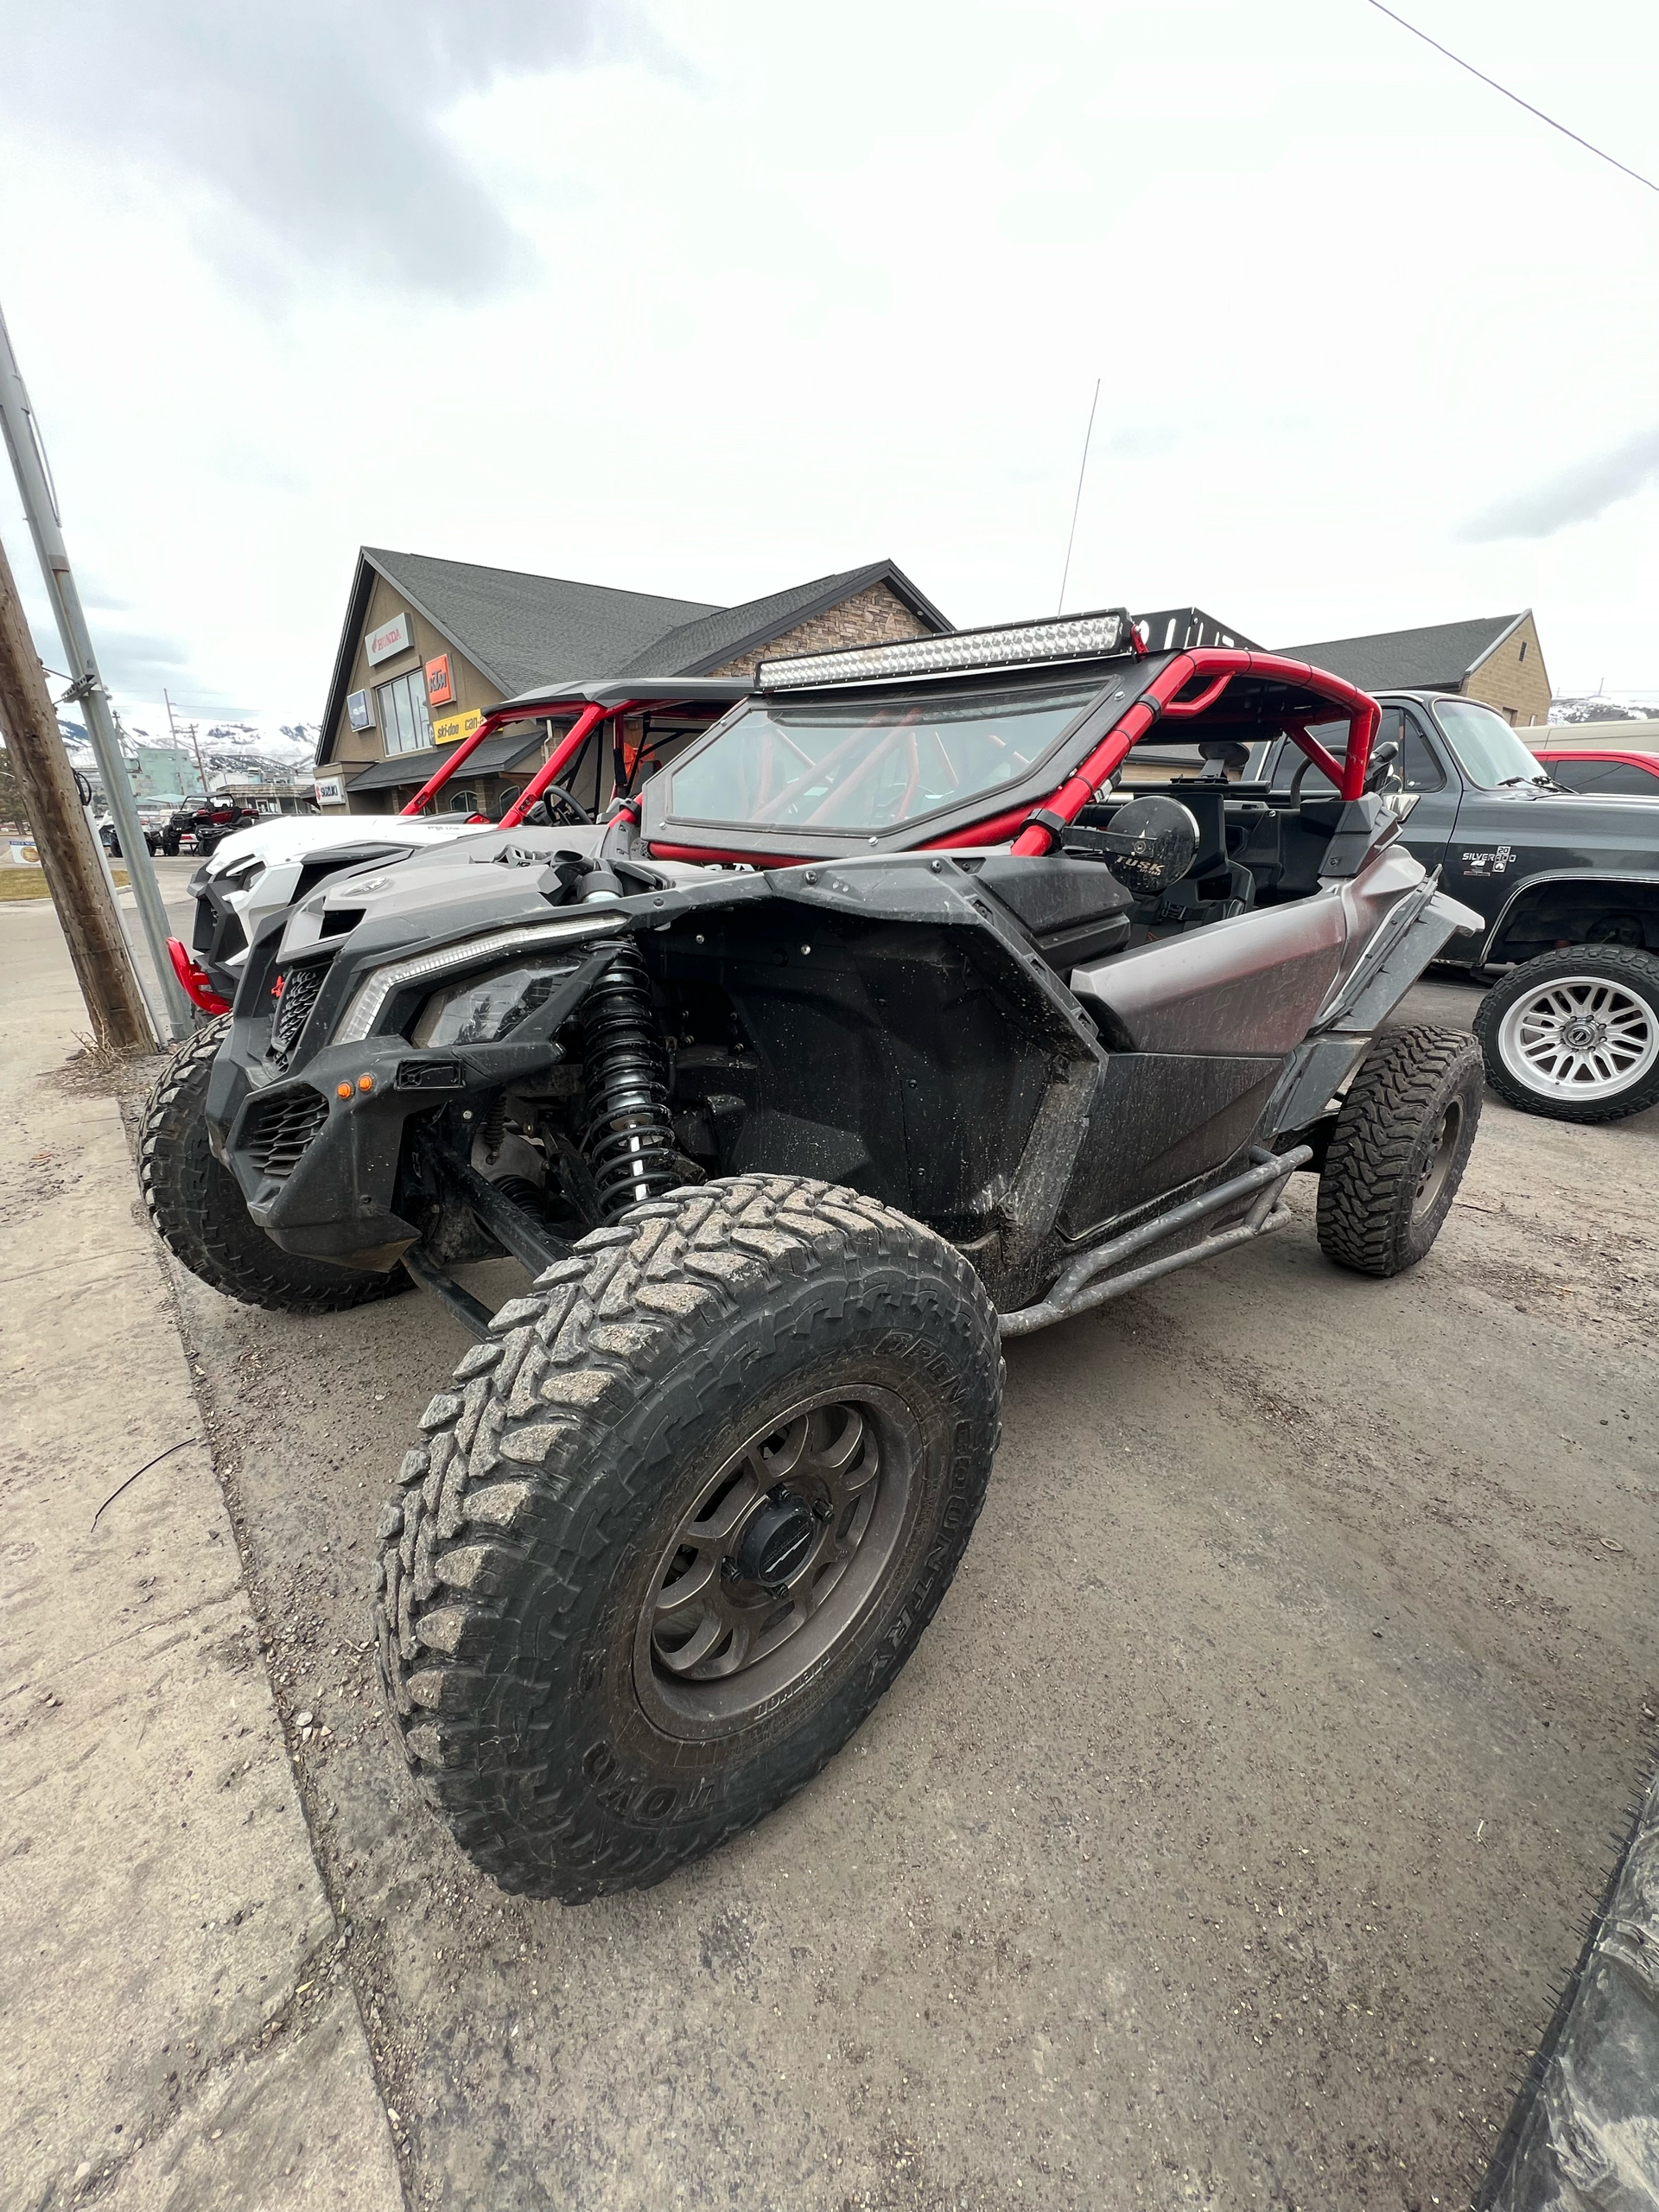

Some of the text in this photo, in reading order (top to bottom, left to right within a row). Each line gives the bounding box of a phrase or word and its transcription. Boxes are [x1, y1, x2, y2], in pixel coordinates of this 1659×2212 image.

[377, 629, 401, 651] HONDA
[429, 669, 447, 693] KTM
[437, 722, 460, 739] ski-doo
[320, 785, 339, 798] SUZUKI
[1116, 855, 1166, 873] TUSK
[1461, 852, 1517, 863] SILVERADO
[873, 1331, 969, 1408] OPEN
[866, 1419, 974, 1691] COUNTRY
[753, 1653, 831, 1720] METHOD
[581, 1738, 715, 1822] TOYO
